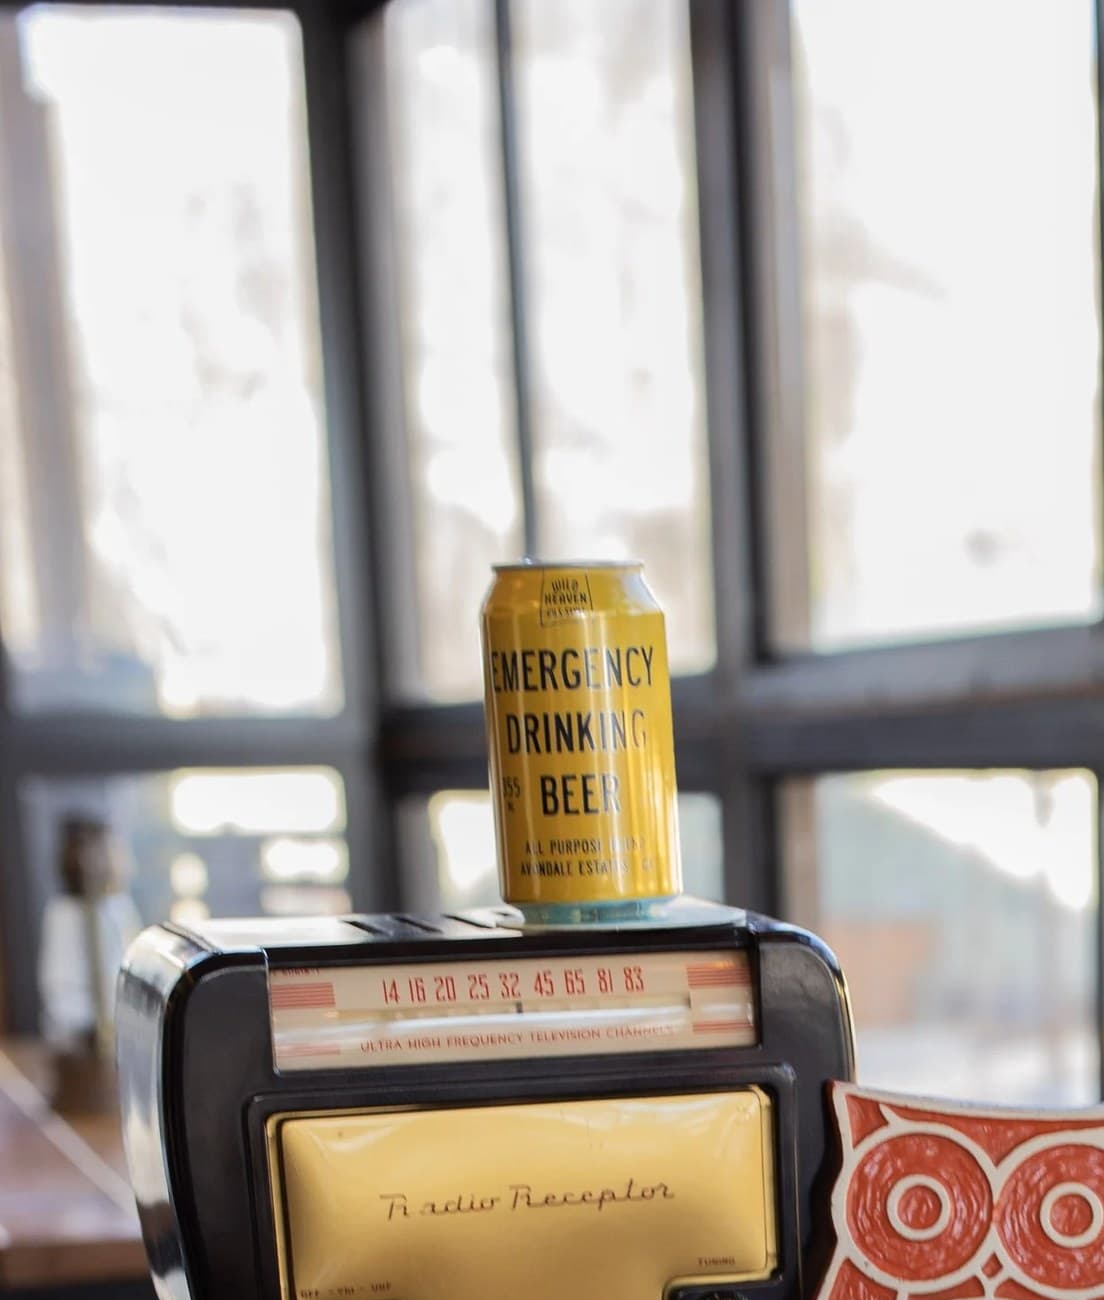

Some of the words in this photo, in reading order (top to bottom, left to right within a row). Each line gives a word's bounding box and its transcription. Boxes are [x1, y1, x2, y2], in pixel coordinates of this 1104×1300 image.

[491, 645, 653, 692] EMERGENCY
[506, 709, 647, 755] DRINKING
[540, 774, 621, 817] BEER
[382, 978, 401, 1005] 14
[408, 976, 426, 1004] 16
[434, 976, 456, 1003] 20
[467, 973, 490, 1001] 25
[499, 971, 521, 999] 32
[534, 969, 555, 997] 45
[564, 968, 585, 995] 65
[597, 967, 614, 993] 81
[623, 966, 645, 993] 83
[361, 1040, 402, 1053] ULTRA
[408, 1037, 441, 1050] HIGH
[446, 1031, 522, 1049] FREQUENCY
[530, 1028, 601, 1043] TELEVISION
[379, 1193, 501, 1222] Radio
[508, 1177, 675, 1213] Receptor
